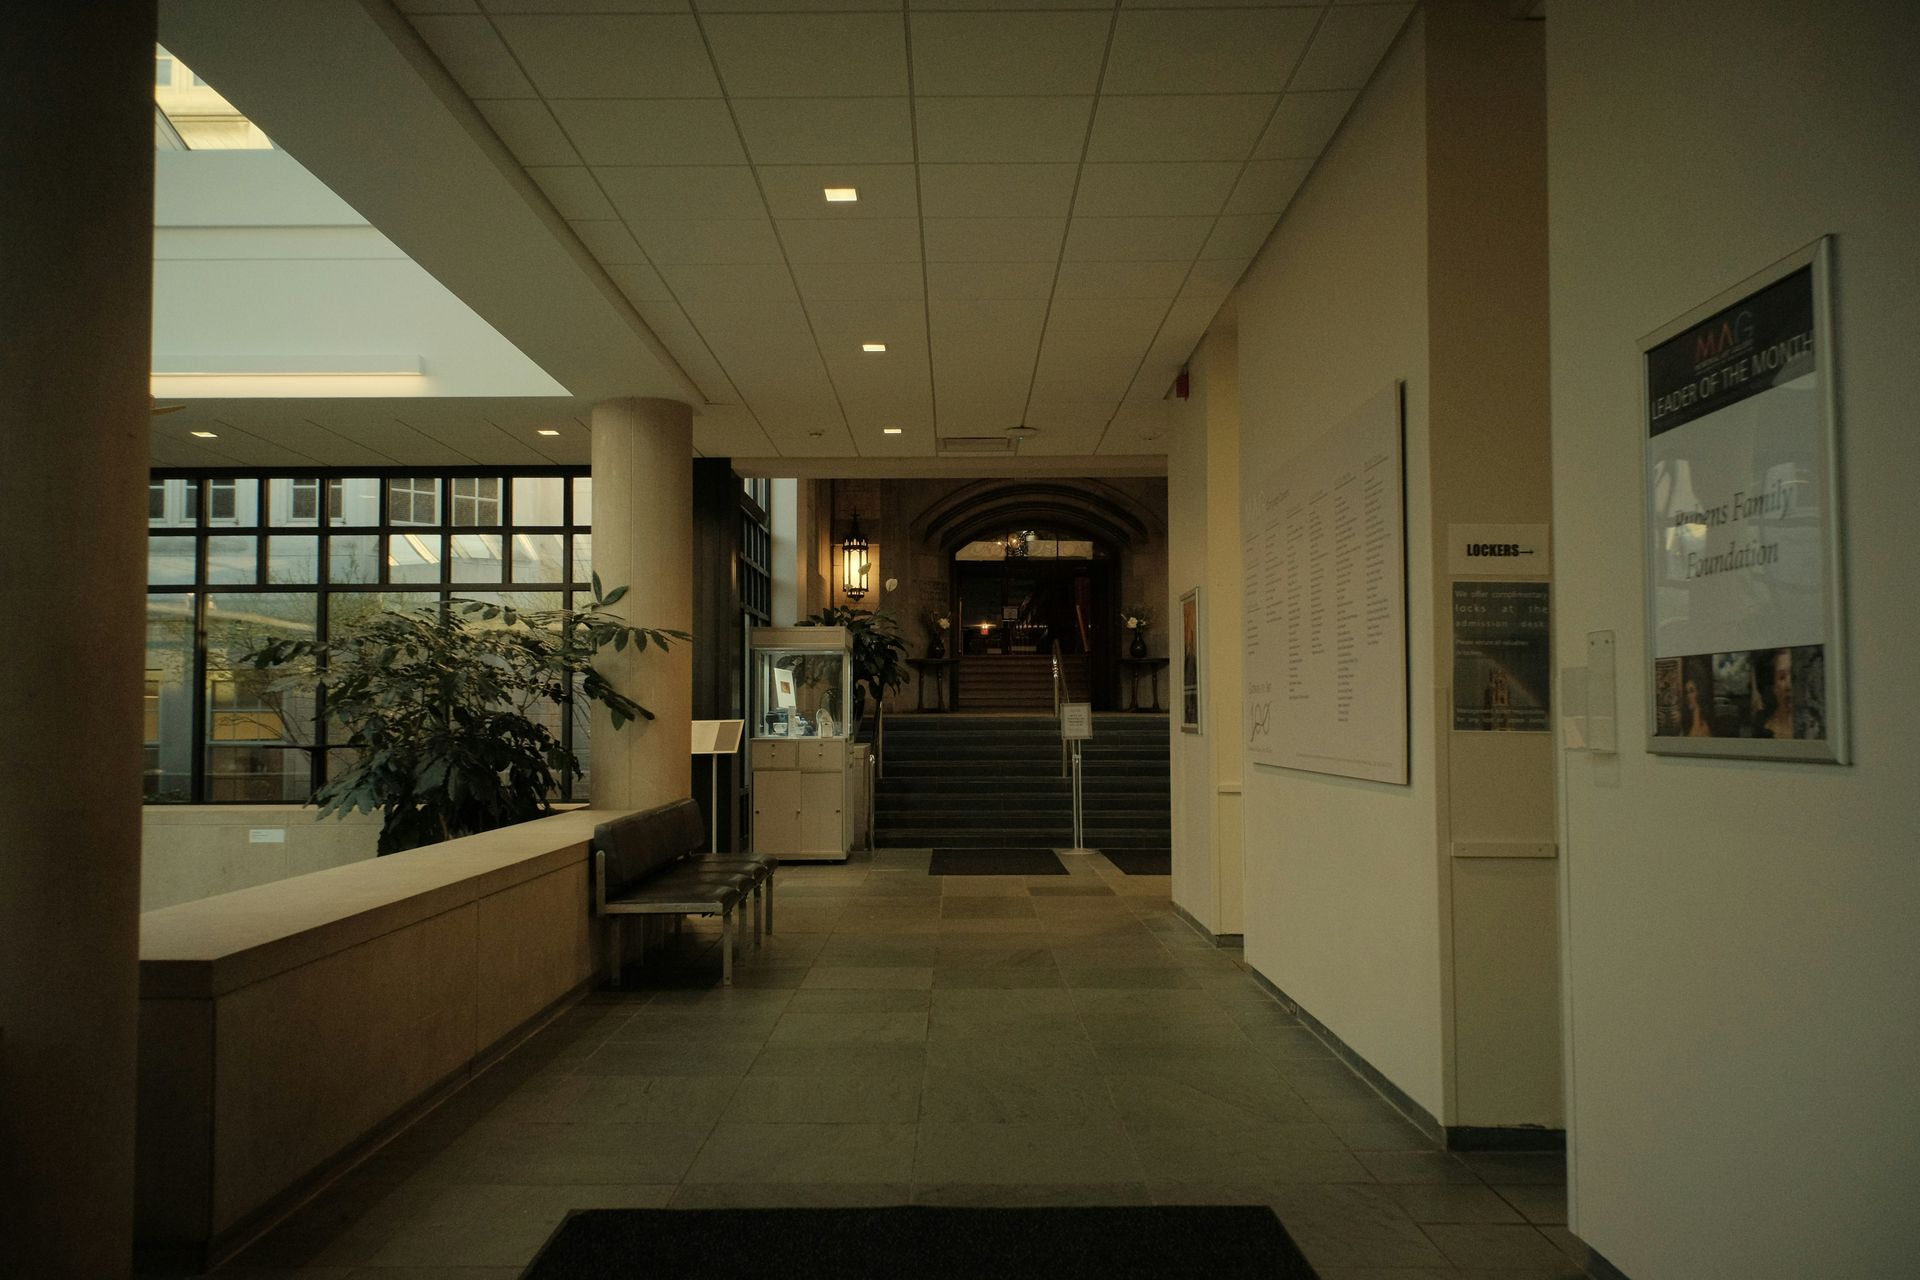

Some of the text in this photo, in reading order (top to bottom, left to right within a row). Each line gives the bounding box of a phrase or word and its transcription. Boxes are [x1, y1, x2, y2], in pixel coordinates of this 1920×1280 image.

[1695, 309, 1754, 363] MAG
[1652, 383, 1698, 420] LEADER
[1699, 371, 1719, 399] OF
[1721, 358, 1749, 388] THE
[1752, 331, 1814, 377] MONTH
[1732, 479, 1794, 522] Family
[1467, 543, 1520, 557] LOCKERS
[1686, 540, 1779, 580] Foundation
[1455, 604, 1549, 613] locks at the
